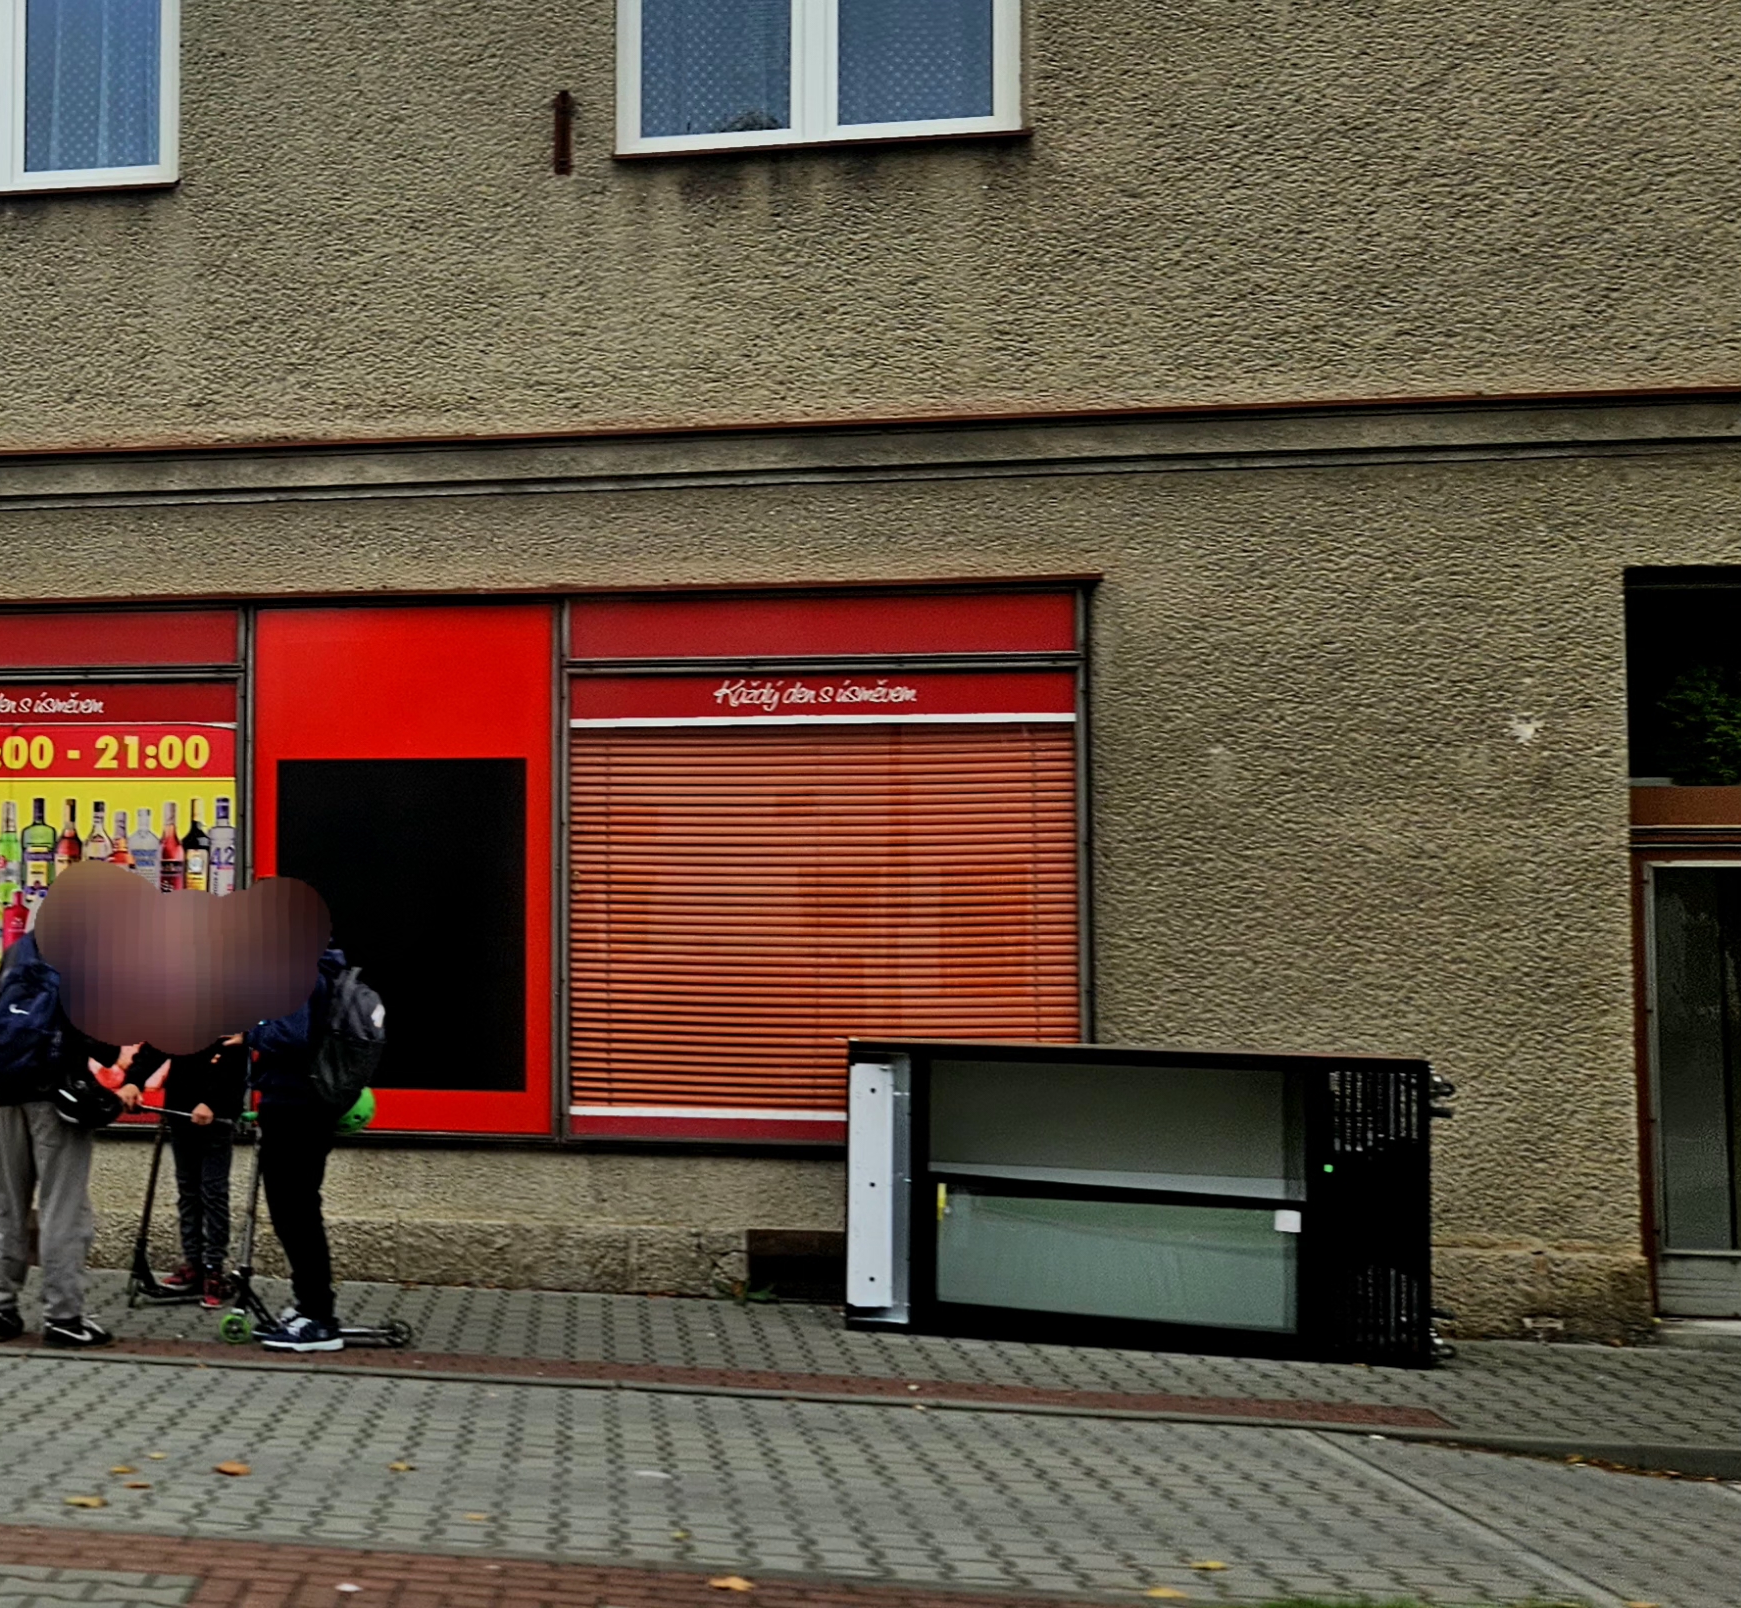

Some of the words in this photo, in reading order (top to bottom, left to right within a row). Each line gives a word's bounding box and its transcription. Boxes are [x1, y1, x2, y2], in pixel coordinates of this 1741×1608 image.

[18, 697, 32, 714] s
[33, 691, 104, 714] úsměvem
[713, 679, 784, 712] Každý
[782, 681, 816, 704] den
[817, 686, 834, 704] s
[836, 679, 918, 703] úsměvem
[67, 749, 80, 760] -
[94, 735, 210, 769] 21:00
